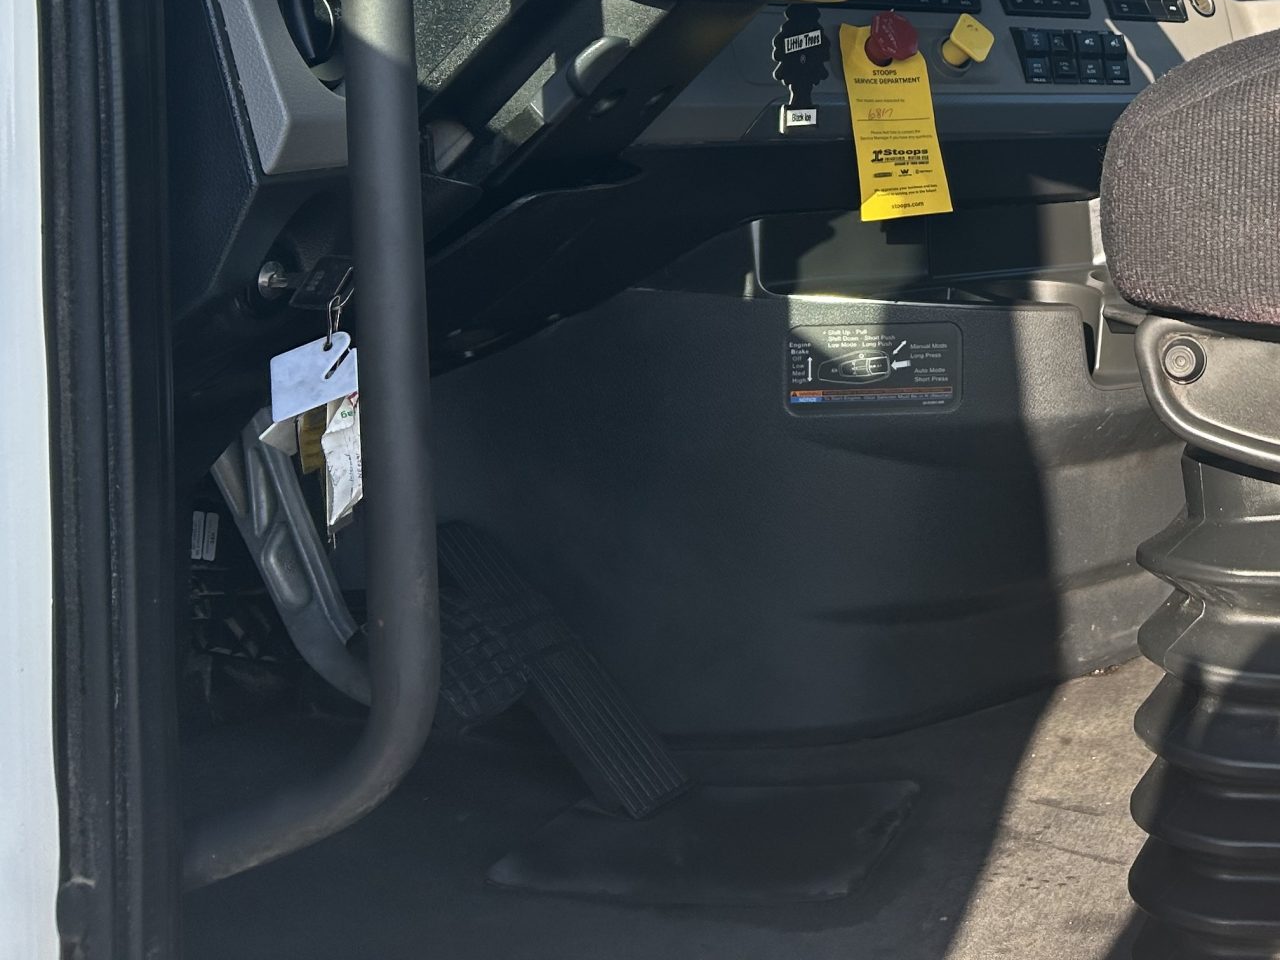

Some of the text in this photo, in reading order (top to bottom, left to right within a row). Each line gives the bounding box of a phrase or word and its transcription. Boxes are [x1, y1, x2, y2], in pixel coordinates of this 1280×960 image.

[786, 33, 820, 51] Little Trees
[879, 76, 921, 85] DEPARTMENT
[882, 148, 928, 156] Stoops
[891, 201, 925, 209] stoops.com
